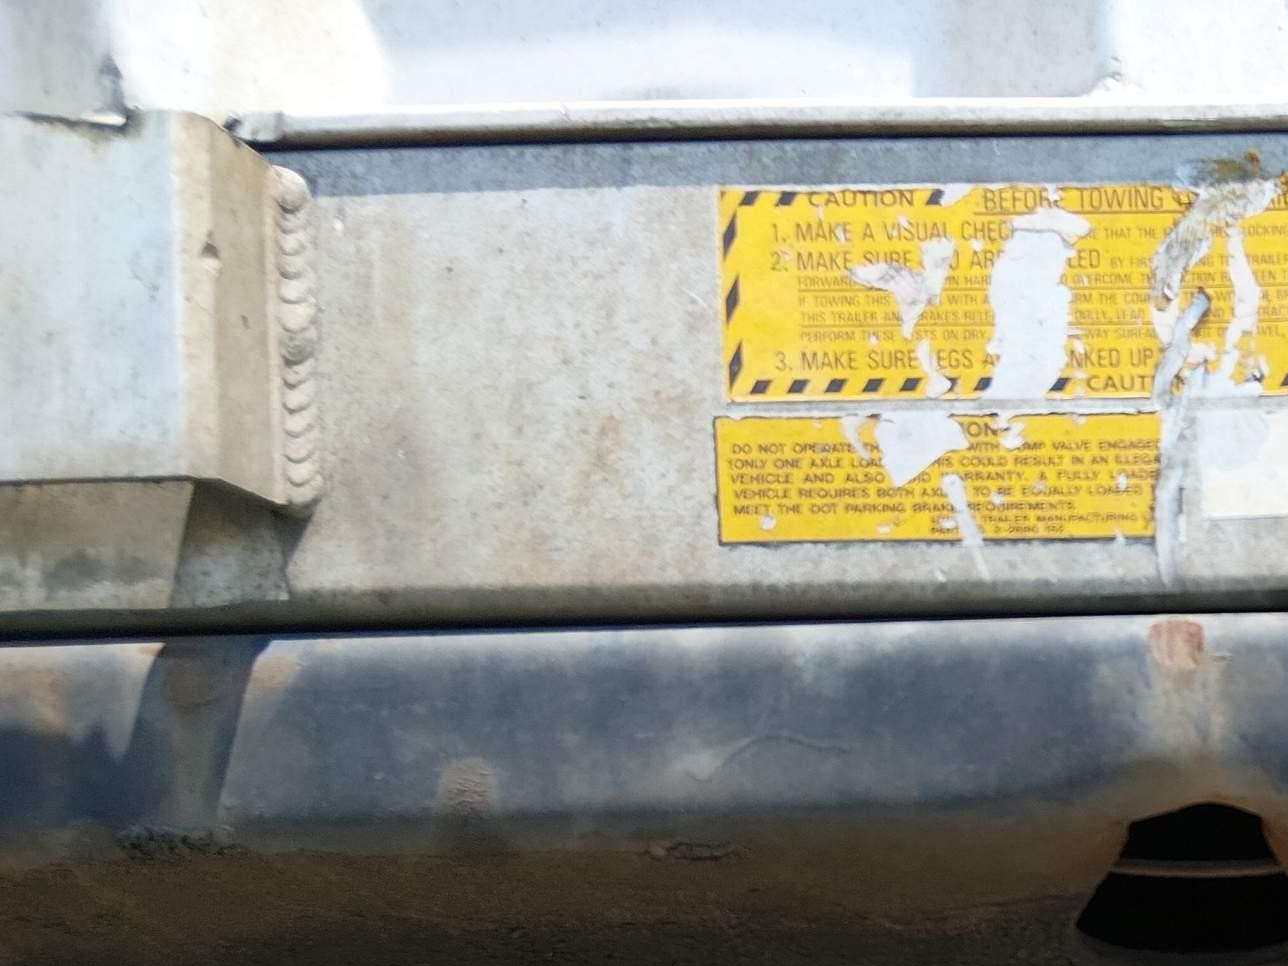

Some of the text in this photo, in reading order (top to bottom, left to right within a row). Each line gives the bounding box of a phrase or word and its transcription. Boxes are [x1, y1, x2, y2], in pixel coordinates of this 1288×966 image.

[807, 189, 914, 208] CAUTION
[1078, 187, 1164, 210] TOWING
[770, 223, 789, 243] 1.
[795, 222, 853, 242] MAKE
[862, 222, 875, 241] A
[883, 221, 949, 242] VISUAL
[796, 250, 852, 271] MAKE
[814, 295, 860, 308] TOWING
[865, 293, 891, 307] THIS
[800, 312, 825, 324] THIS
[831, 311, 878, 323] TRAILER
[884, 310, 904, 323] AN
[920, 311, 960, 323] RAKES
[800, 329, 857, 343] PERFORM
[775, 351, 793, 372] 3.
[801, 350, 859, 371] MAKE
[867, 349, 918, 370] SURE
[937, 349, 974, 369] EGS
[1069, 348, 1120, 370] NKED
[1130, 348, 1154, 368] UP
[1086, 375, 1154, 392] CAUT
[731, 442, 752, 455] DO
[758, 442, 786, 455] NOT
[792, 441, 857, 454] OPERATE
[1051, 439, 1090, 451] VALVE
[773, 457, 803, 469] ONE
[809, 457, 843, 469] AXLE
[959, 455, 1009, 468] COULD
[1013, 454, 1064, 467] RESULT
[1071, 453, 1085, 465] IN
[1090, 453, 1110, 465] AN
[1114, 452, 1161, 465] ILLEGA
[730, 472, 793, 485] VEHICLE
[803, 471, 836, 485] AND
[845, 471, 886, 484] ALSO
[1038, 470, 1048, 481] A
[1056, 470, 1099, 482] FULLY
[734, 487, 791, 500] VEHICLE
[797, 487, 870, 499] REQUIRES
[876, 486, 915, 498] BOTH
[973, 486, 991, 498] TO
[1021, 485, 1083, 498] EQUALLY
[733, 502, 770, 516] MEET
[777, 502, 803, 514] THE
[809, 502, 838, 515] DOT
[843, 502, 906, 513] PARKING
[912, 502, 955, 513] BRAK
